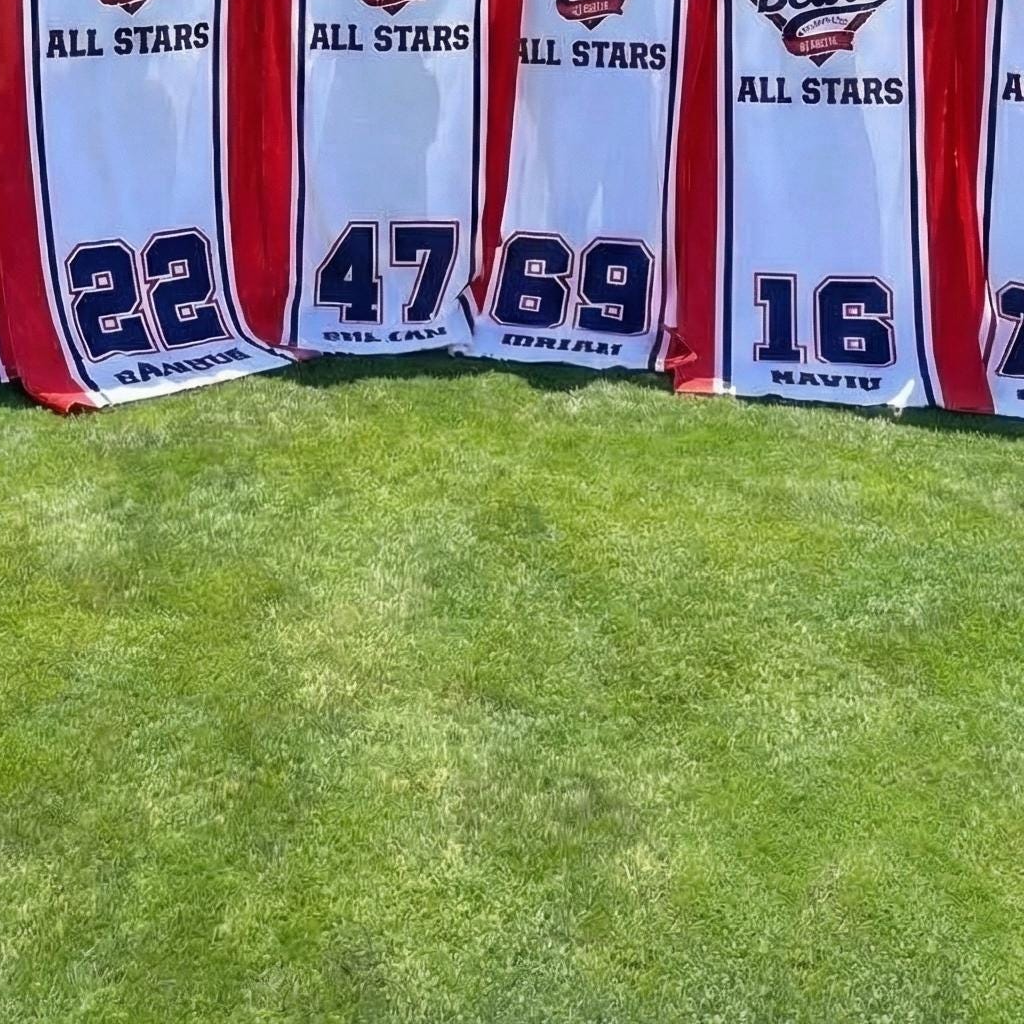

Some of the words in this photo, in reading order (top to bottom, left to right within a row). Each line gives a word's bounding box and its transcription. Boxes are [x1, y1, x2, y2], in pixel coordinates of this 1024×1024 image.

[46, 29, 104, 58] ALL
[113, 22, 209, 56] STARS
[310, 23, 364, 51] ALL
[373, 24, 470, 52] STARS
[520, 38, 561, 65] ALL
[572, 40, 667, 71] STARS
[737, 77, 792, 104] ALL
[801, 77, 904, 105] STARS
[64, 227, 234, 363] 22
[314, 221, 459, 325] 47
[489, 231, 655, 335] 69
[753, 273, 895, 366] 16
